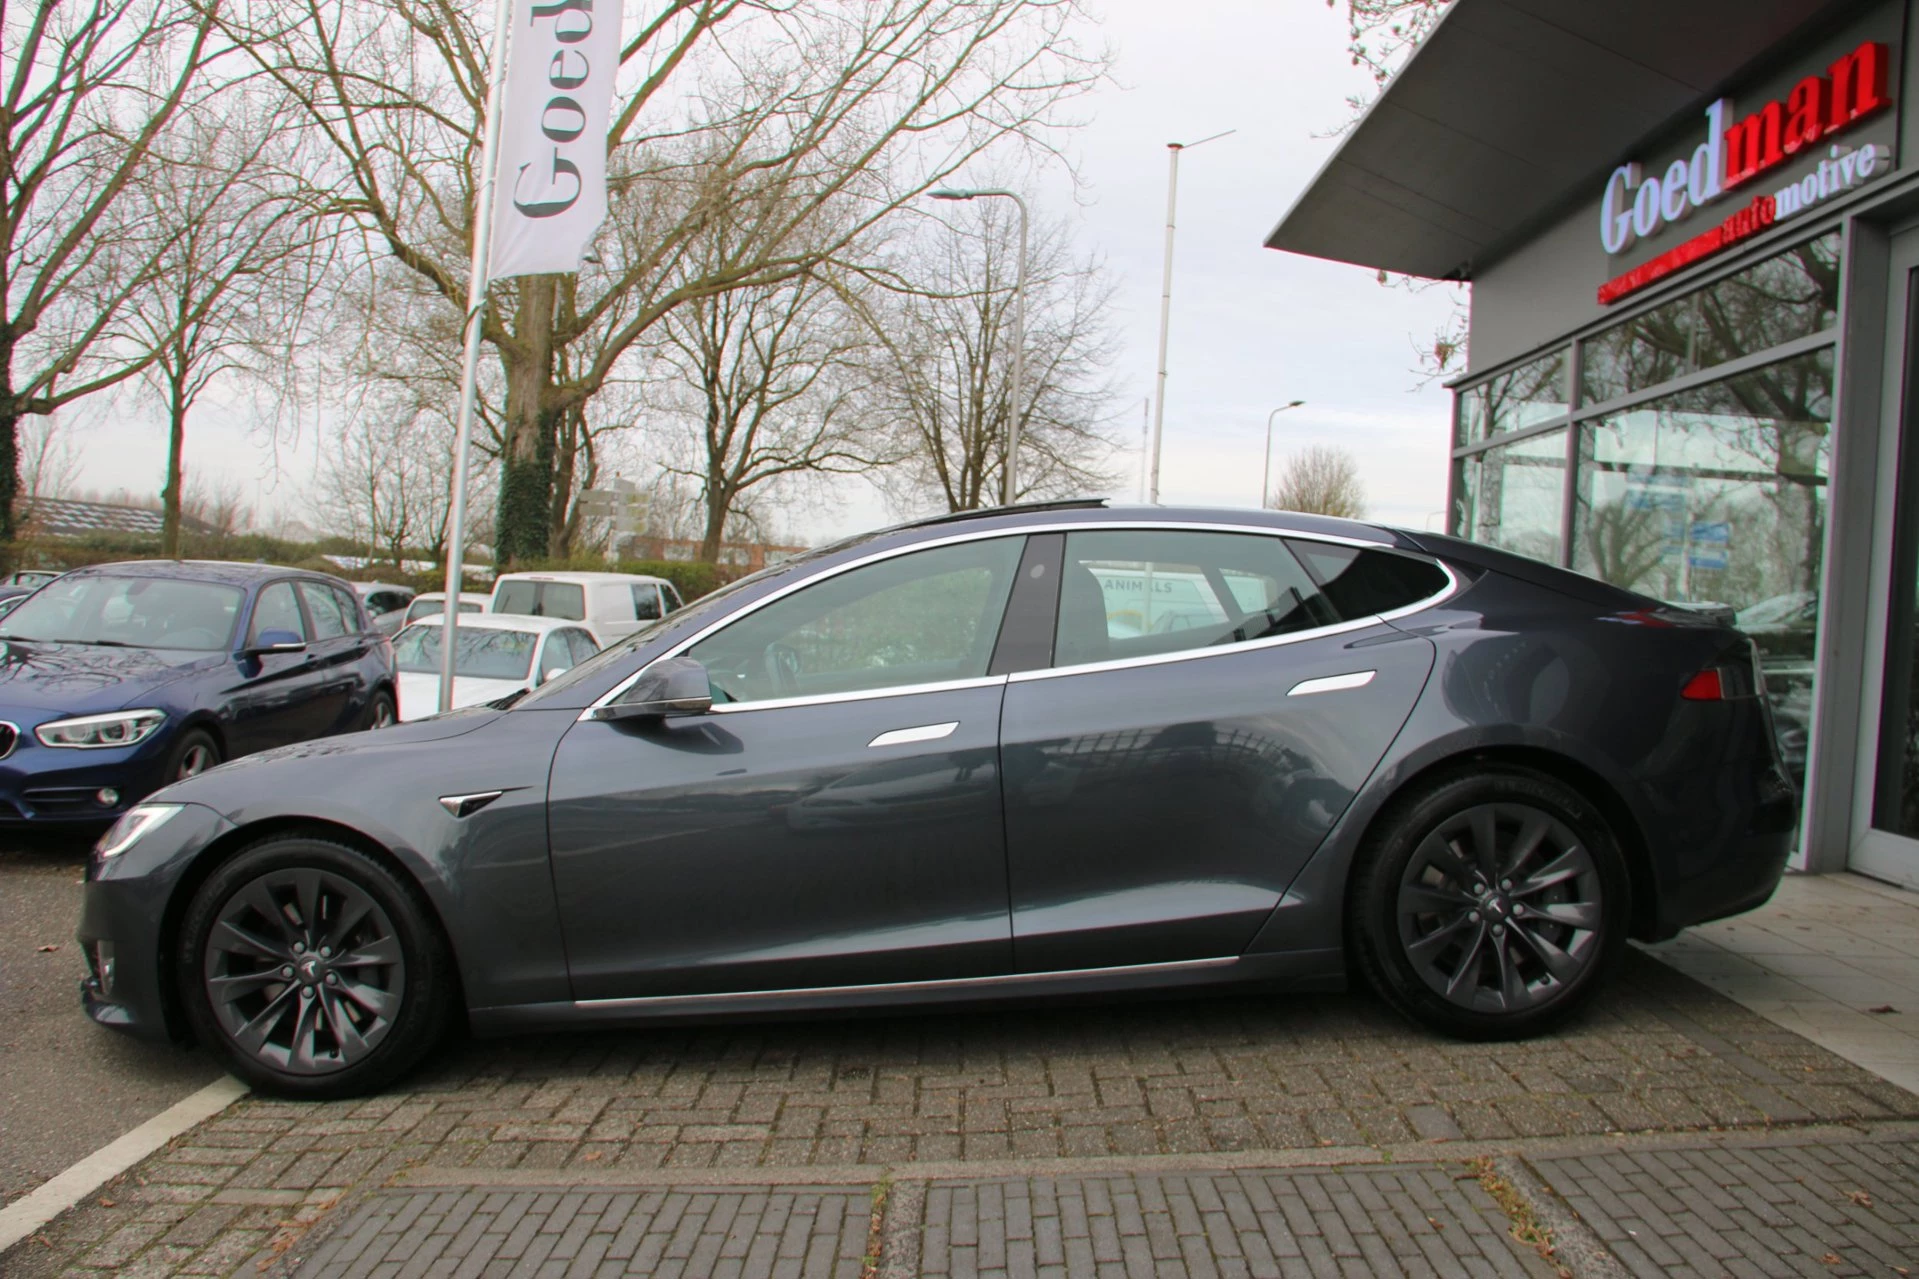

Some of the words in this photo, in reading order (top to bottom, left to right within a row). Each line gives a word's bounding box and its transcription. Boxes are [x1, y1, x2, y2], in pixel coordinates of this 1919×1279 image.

[1600, 40, 1888, 254] Goedman
[1721, 143, 1889, 245] automotive
[1103, 579, 1174, 593] ANIMLS
